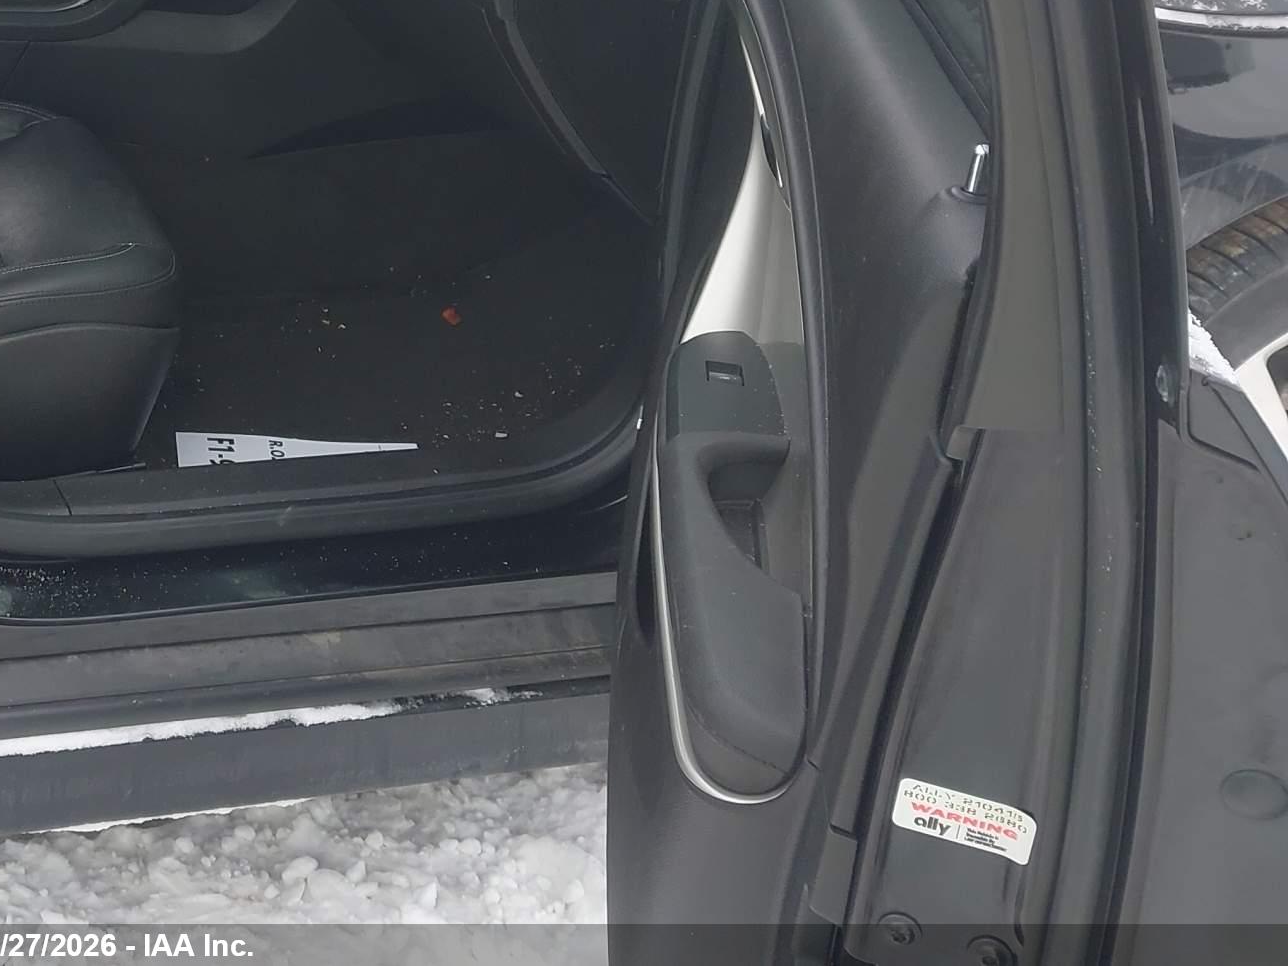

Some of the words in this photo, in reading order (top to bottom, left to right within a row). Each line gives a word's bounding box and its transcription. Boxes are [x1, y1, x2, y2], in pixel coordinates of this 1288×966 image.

[904, 790, 937, 804] 800
[913, 784, 955, 801] ALLY
[911, 802, 1018, 841] WARNING
[914, 816, 951, 835] ally
